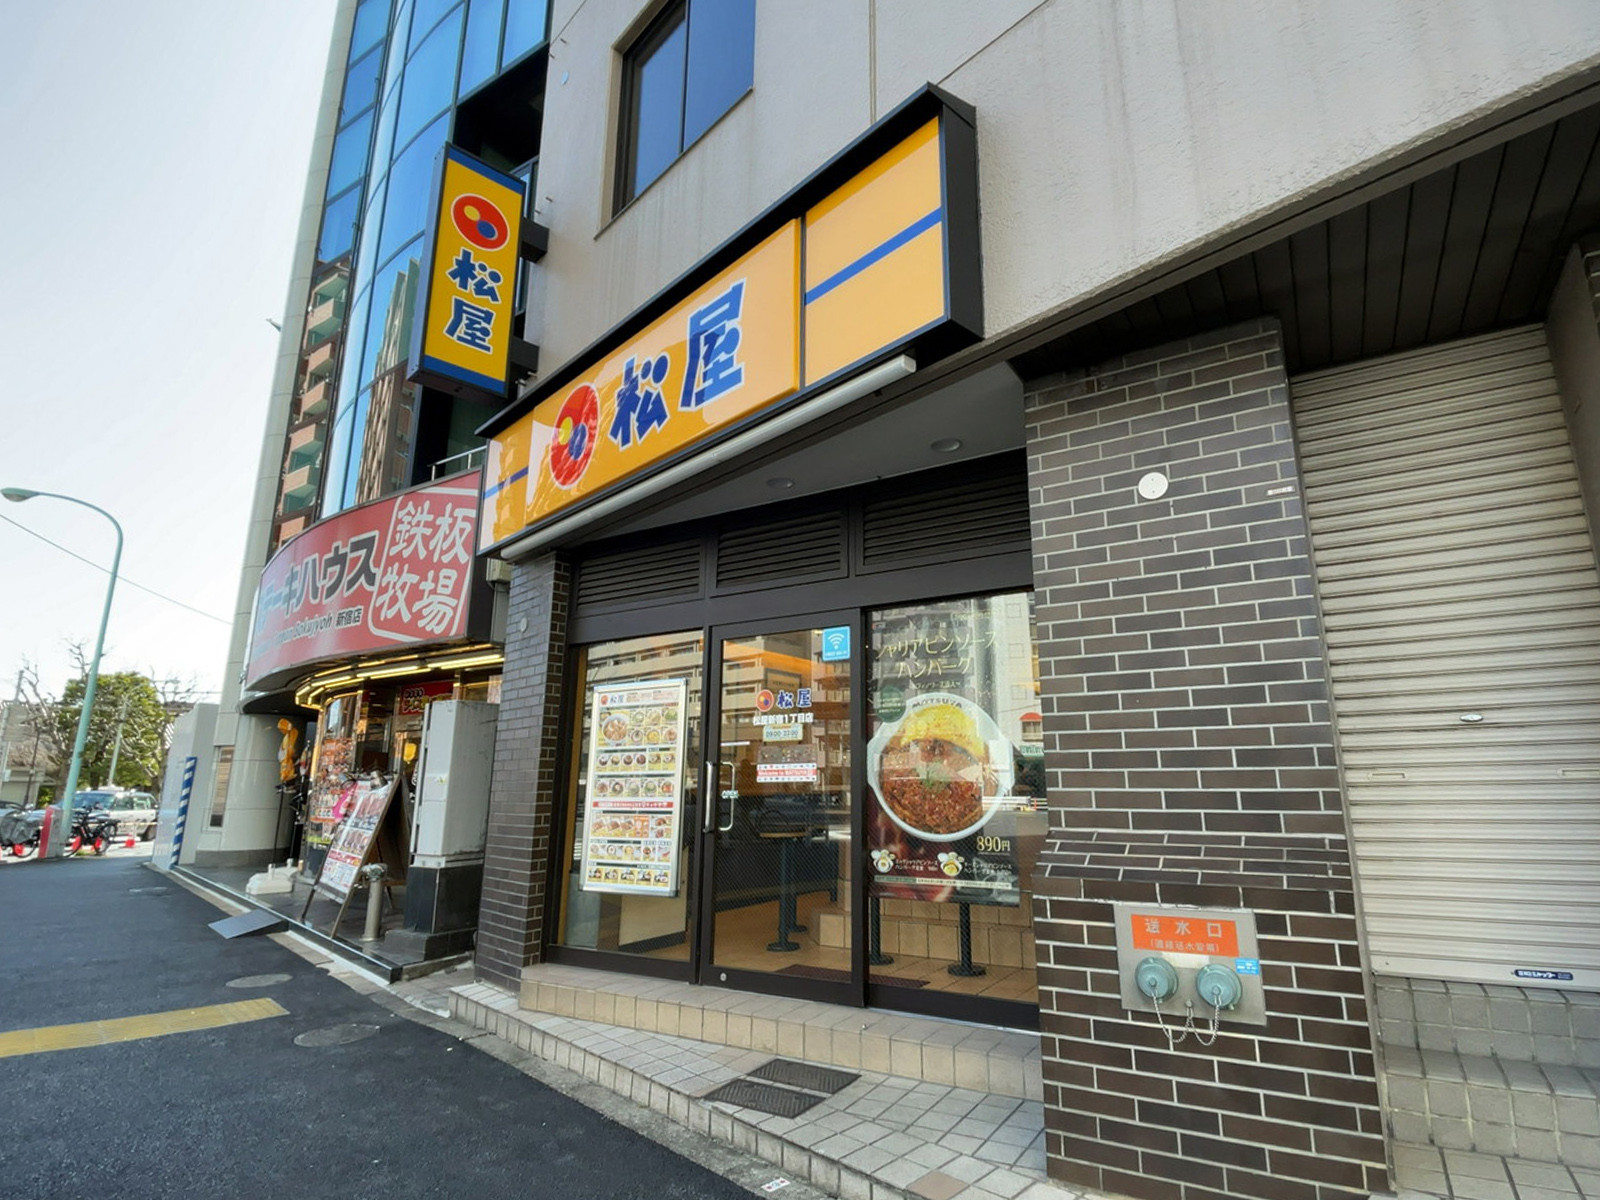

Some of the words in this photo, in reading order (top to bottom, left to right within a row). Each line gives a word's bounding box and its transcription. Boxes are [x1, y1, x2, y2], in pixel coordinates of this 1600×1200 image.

[444, 247, 502, 354] 松屋
[609, 278, 746, 450] 松屋
[389, 500, 477, 565] 鉄板
[335, 607, 363, 628] 新宿店
[375, 563, 460, 636] 牧場
[777, 689, 811, 708] 松屋
[976, 836, 1011, 852] 890円
[1144, 918, 1222, 938] 送水口
